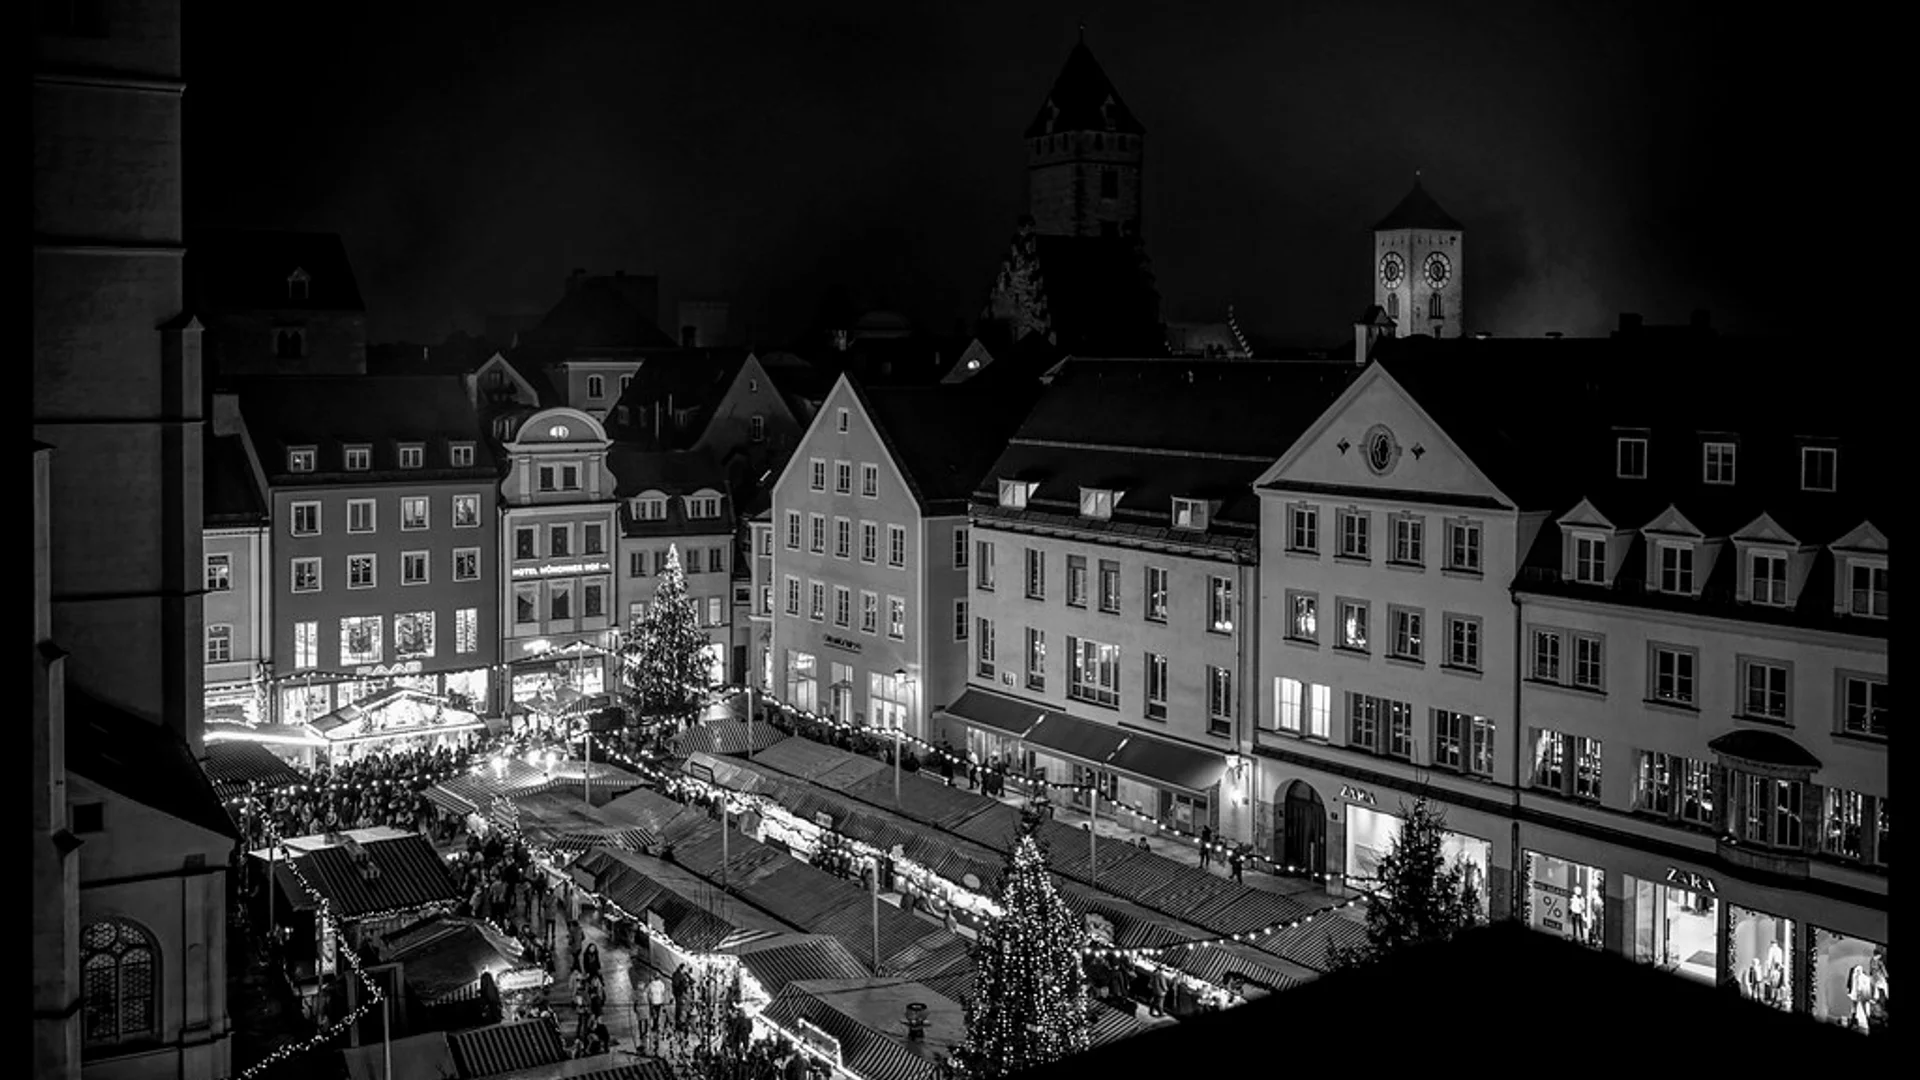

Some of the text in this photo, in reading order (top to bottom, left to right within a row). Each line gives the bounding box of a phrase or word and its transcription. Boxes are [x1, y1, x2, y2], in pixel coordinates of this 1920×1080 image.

[512, 567, 538, 577] HOTEL
[1340, 784, 1377, 805] ZARA
[1666, 867, 1717, 893] ZARA
[1543, 896, 1562, 918] %
